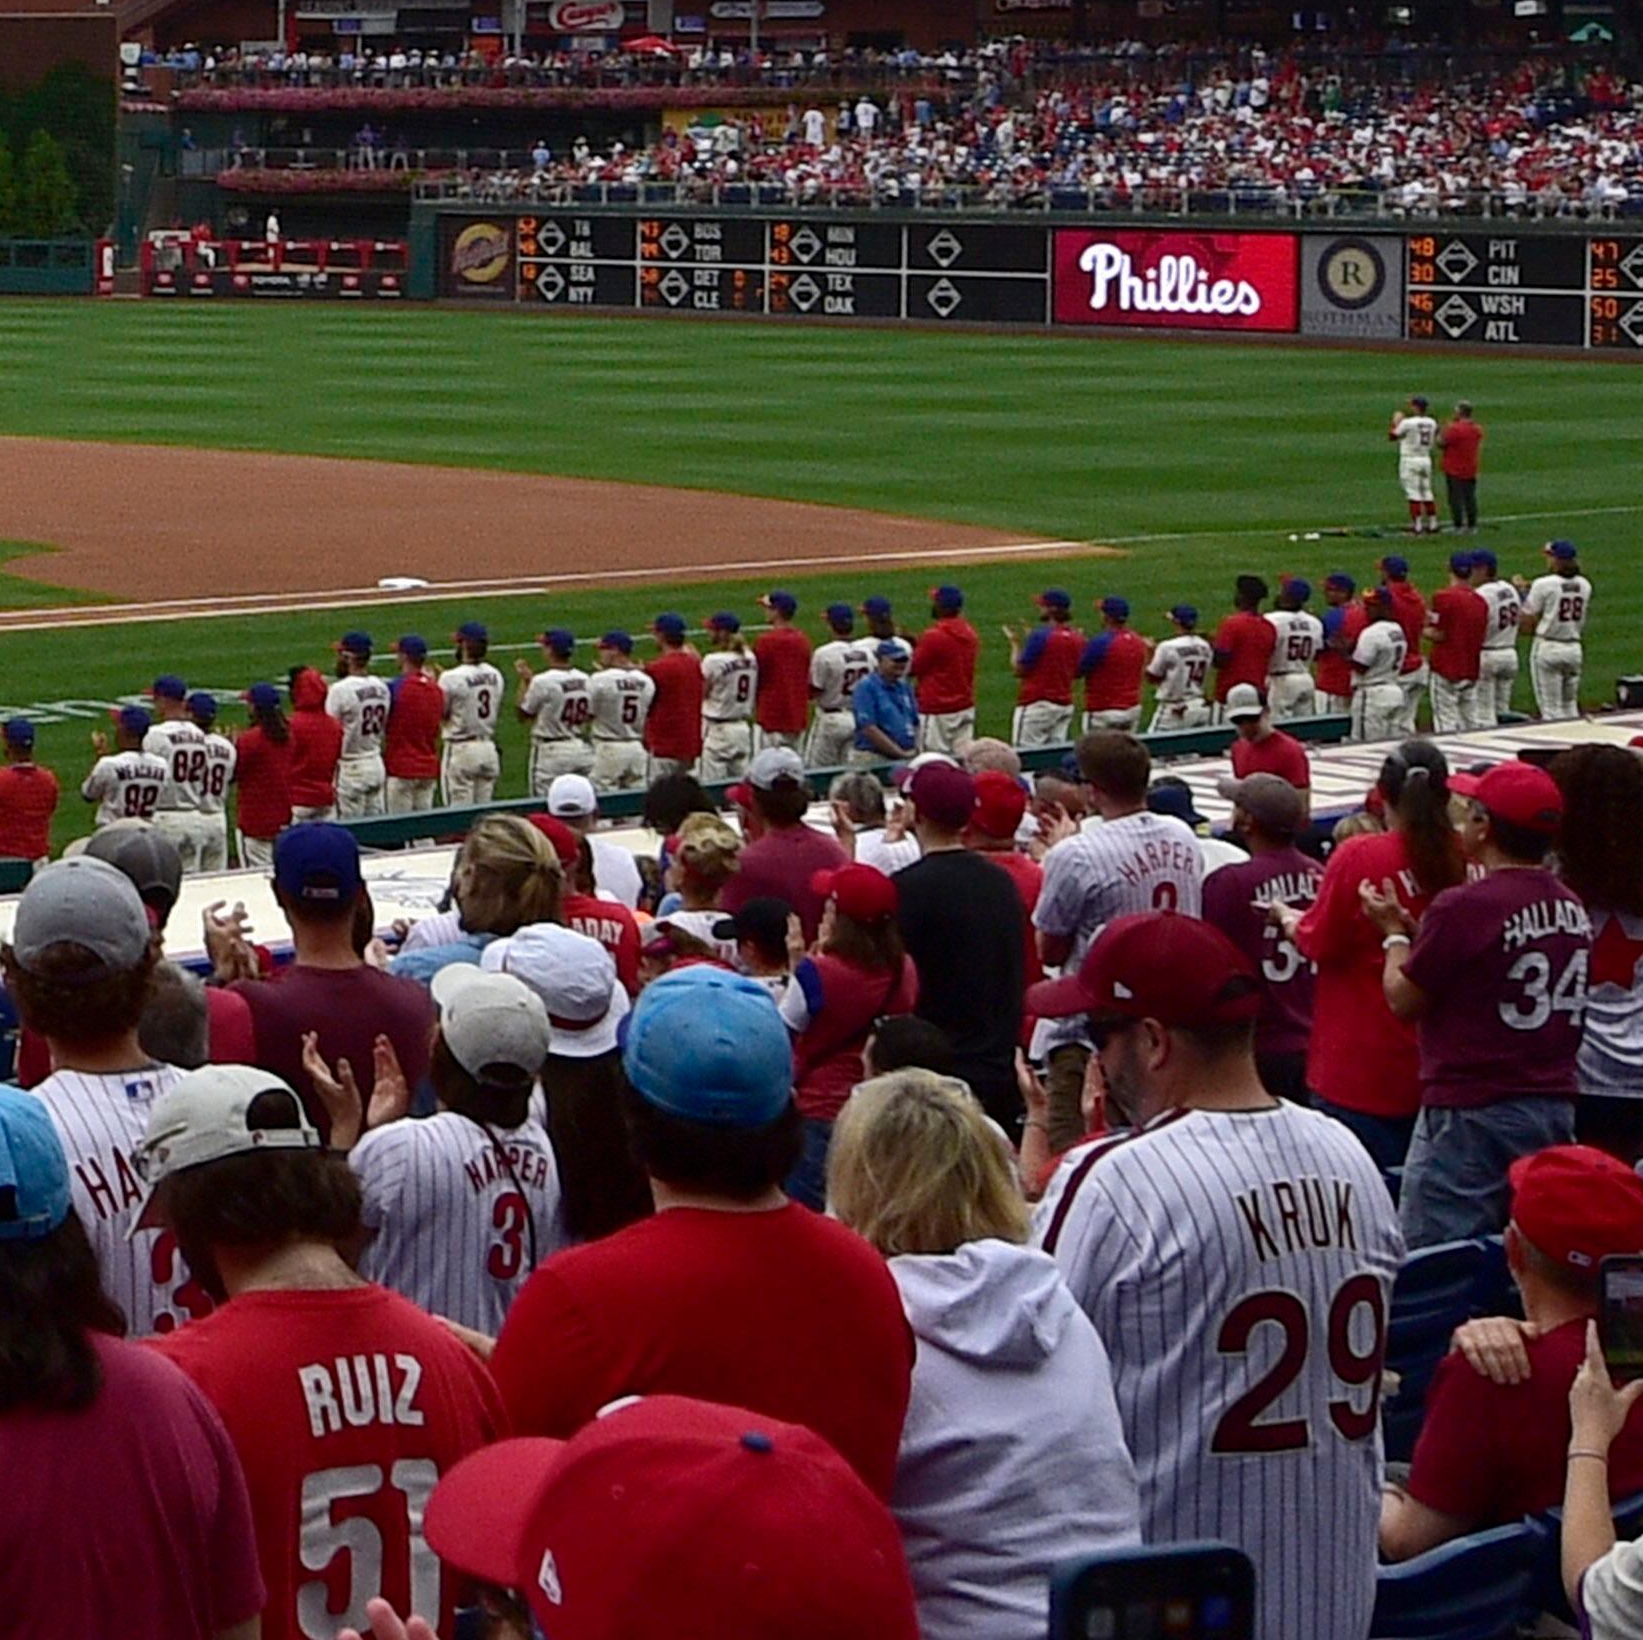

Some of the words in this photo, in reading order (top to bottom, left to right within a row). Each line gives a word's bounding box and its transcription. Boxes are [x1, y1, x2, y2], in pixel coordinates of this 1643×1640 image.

[825, 247, 857, 266] HOU
[1488, 239, 1518, 259] PIT
[826, 274, 854, 292] TEX
[1079, 242, 1261, 316] Phillies
[1341, 261, 1365, 286] R
[1487, 265, 1520, 286] CIN
[1480, 294, 1526, 316] WSH
[1484, 320, 1520, 342] ATL
[477, 688, 492, 719] 3
[1117, 838, 1200, 887] HARPER
[1498, 948, 1590, 1030] 34
[486, 1191, 531, 1281] 3
[1239, 1177, 1358, 1265] KRUK
[1210, 1274, 1389, 1458] 29
[298, 1352, 426, 1437] RUIZ
[296, 1458, 442, 1640] 51
